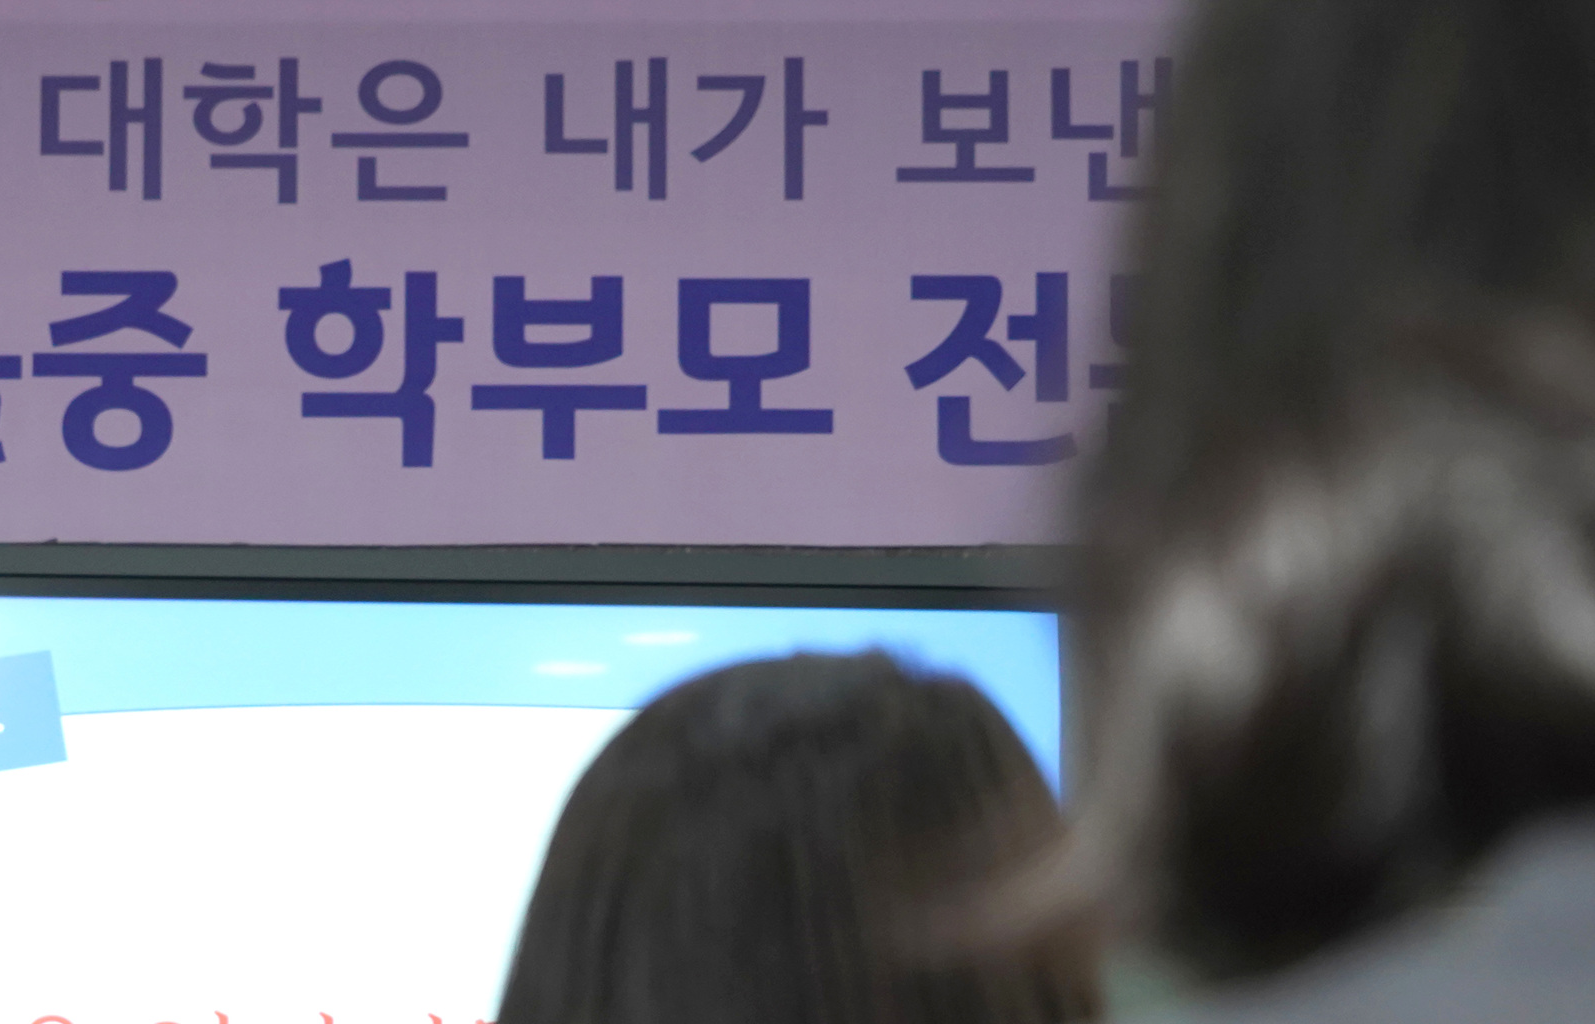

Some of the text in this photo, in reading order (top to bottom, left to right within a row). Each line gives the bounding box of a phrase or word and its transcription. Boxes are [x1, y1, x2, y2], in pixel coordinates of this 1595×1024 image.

[40, 57, 470, 204] 대학은
[544, 57, 829, 201] 내가
[278, 258, 834, 468] 학부모
[904, 271, 1137, 467] 전
